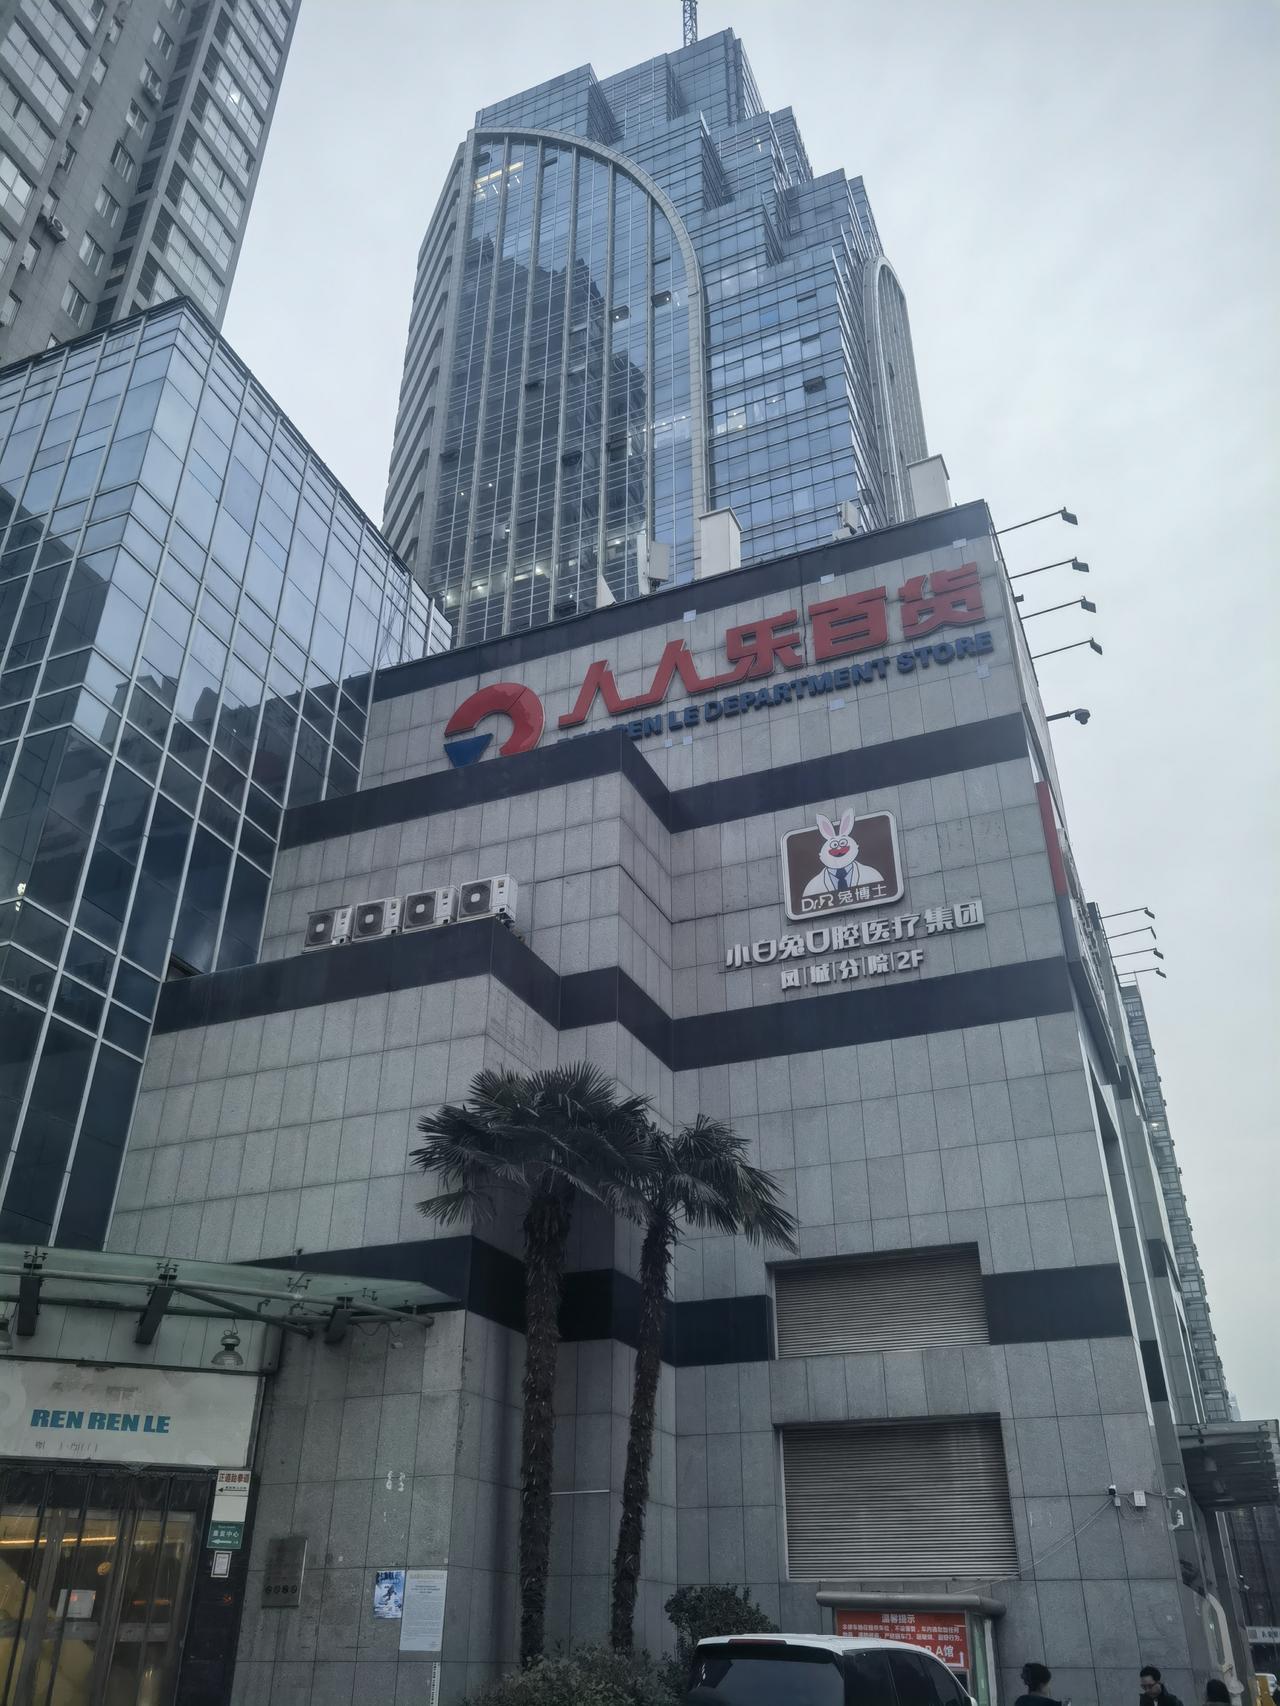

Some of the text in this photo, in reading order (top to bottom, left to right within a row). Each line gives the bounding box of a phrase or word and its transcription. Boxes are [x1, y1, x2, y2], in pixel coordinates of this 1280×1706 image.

[558, 561, 988, 729] 人人乐百货
[612, 709, 662, 741] EN
[668, 700, 700, 732] LE
[704, 656, 891, 724] DEPARTMENT
[897, 630, 995, 673] STORE
[838, 884, 888, 904] 兔博士
[726, 900, 985, 968] 小白兔口腔医疗集团
[30, 1409, 171, 1434] REN REN LE
